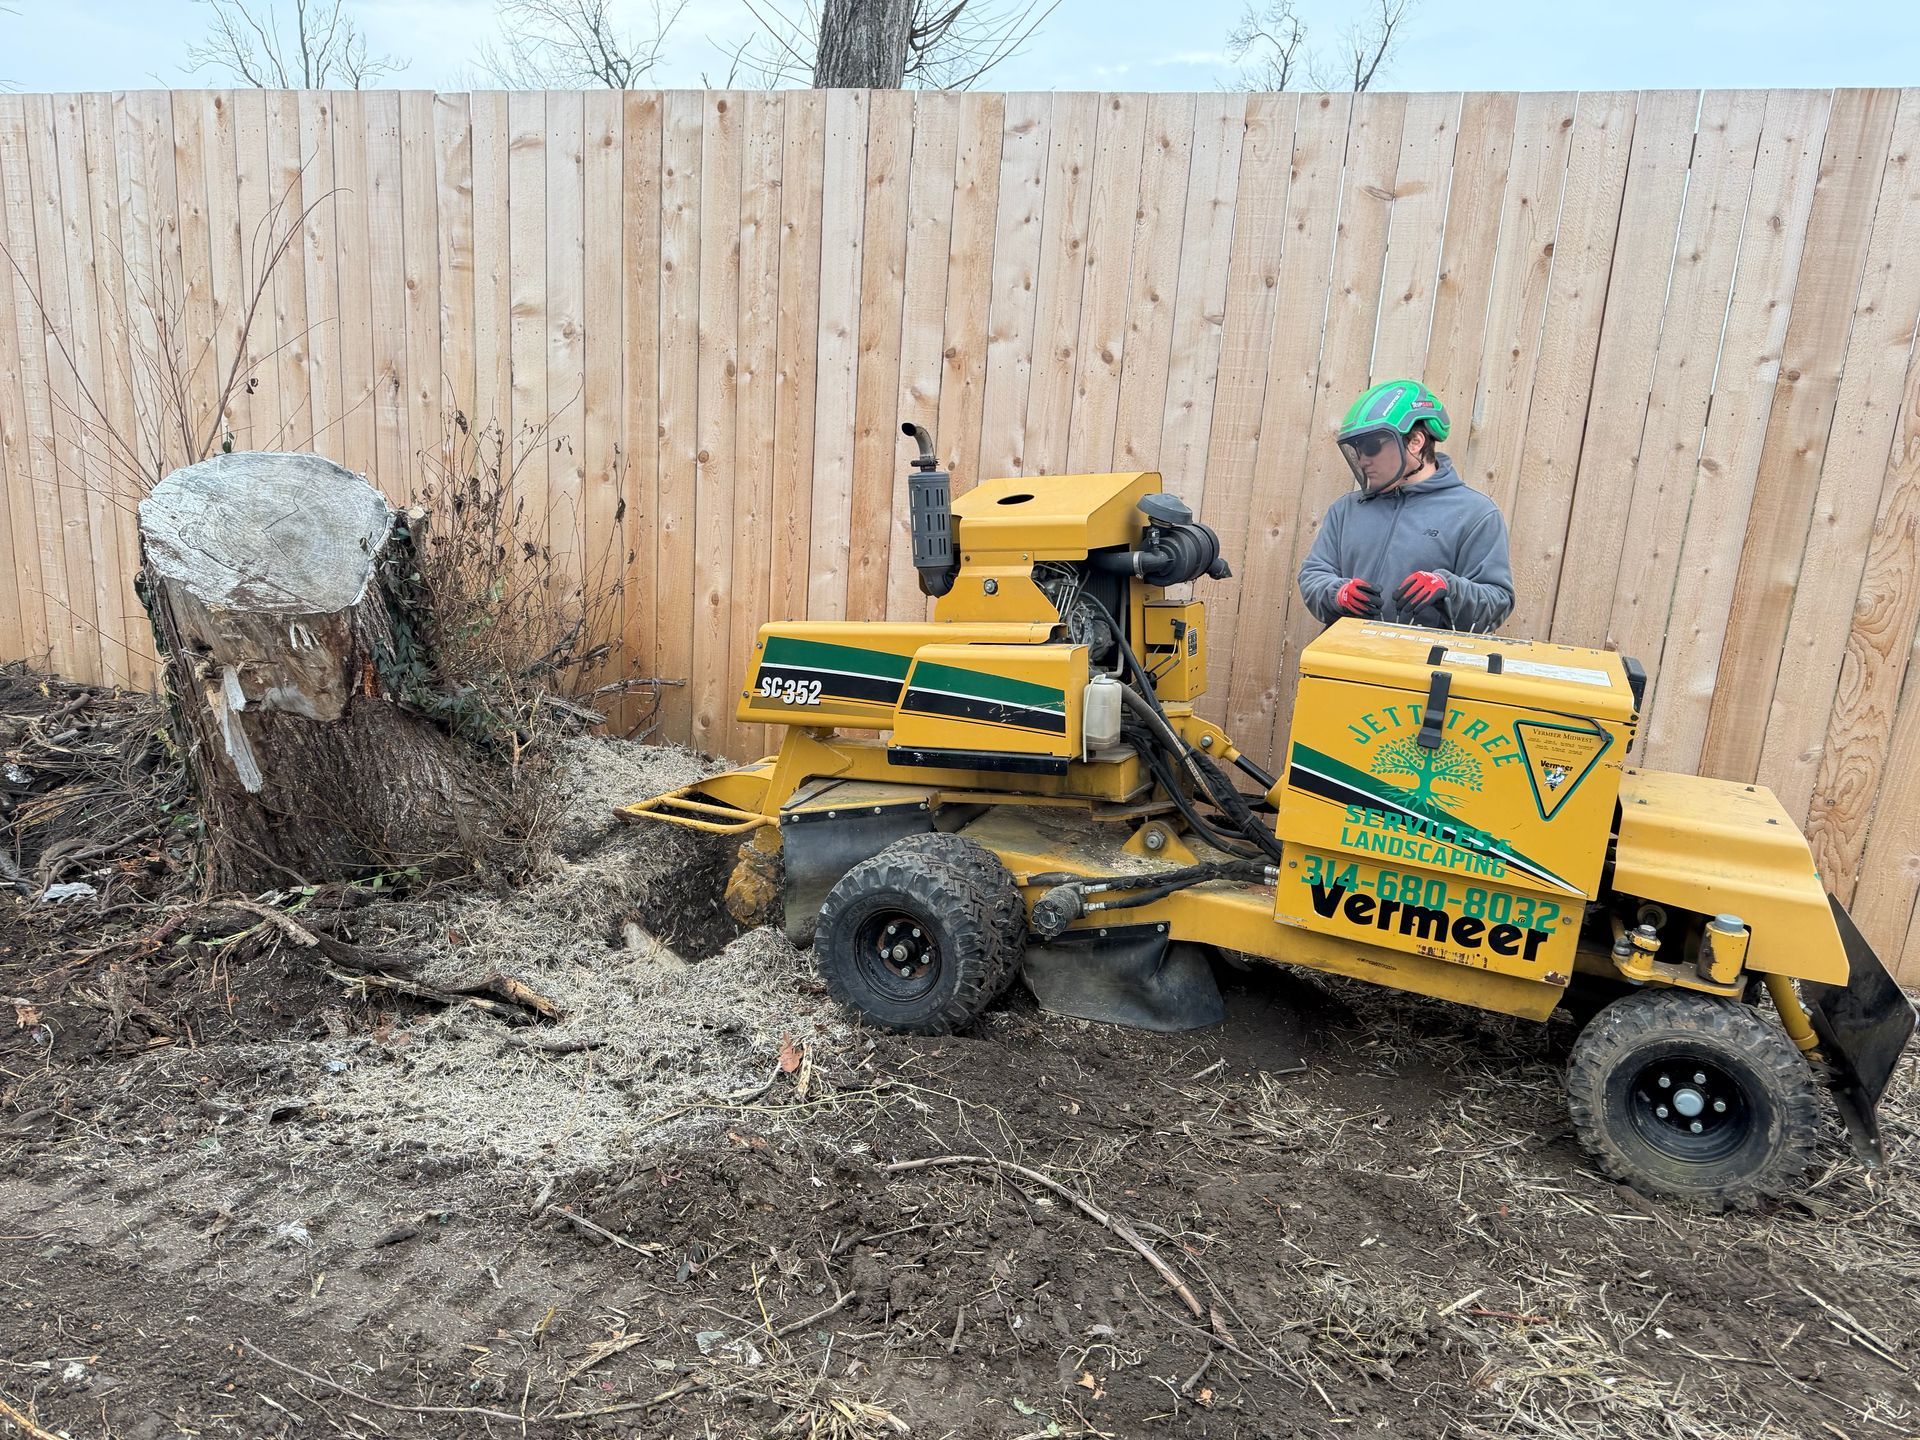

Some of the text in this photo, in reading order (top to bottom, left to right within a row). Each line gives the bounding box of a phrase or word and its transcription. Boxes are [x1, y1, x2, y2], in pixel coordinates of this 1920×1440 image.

[760, 676, 822, 706] SC352
[1347, 704, 1523, 768] JETT TREE
[1532, 728, 1562, 738] VERMEER
[1562, 733, 1593, 744] MIDWEST
[1340, 826, 1507, 879] LANDSCAPING
[1344, 804, 1514, 855] SERVICES &
[1301, 854, 1560, 935] 314-680-8032
[1309, 875, 1548, 962] Vermeer
